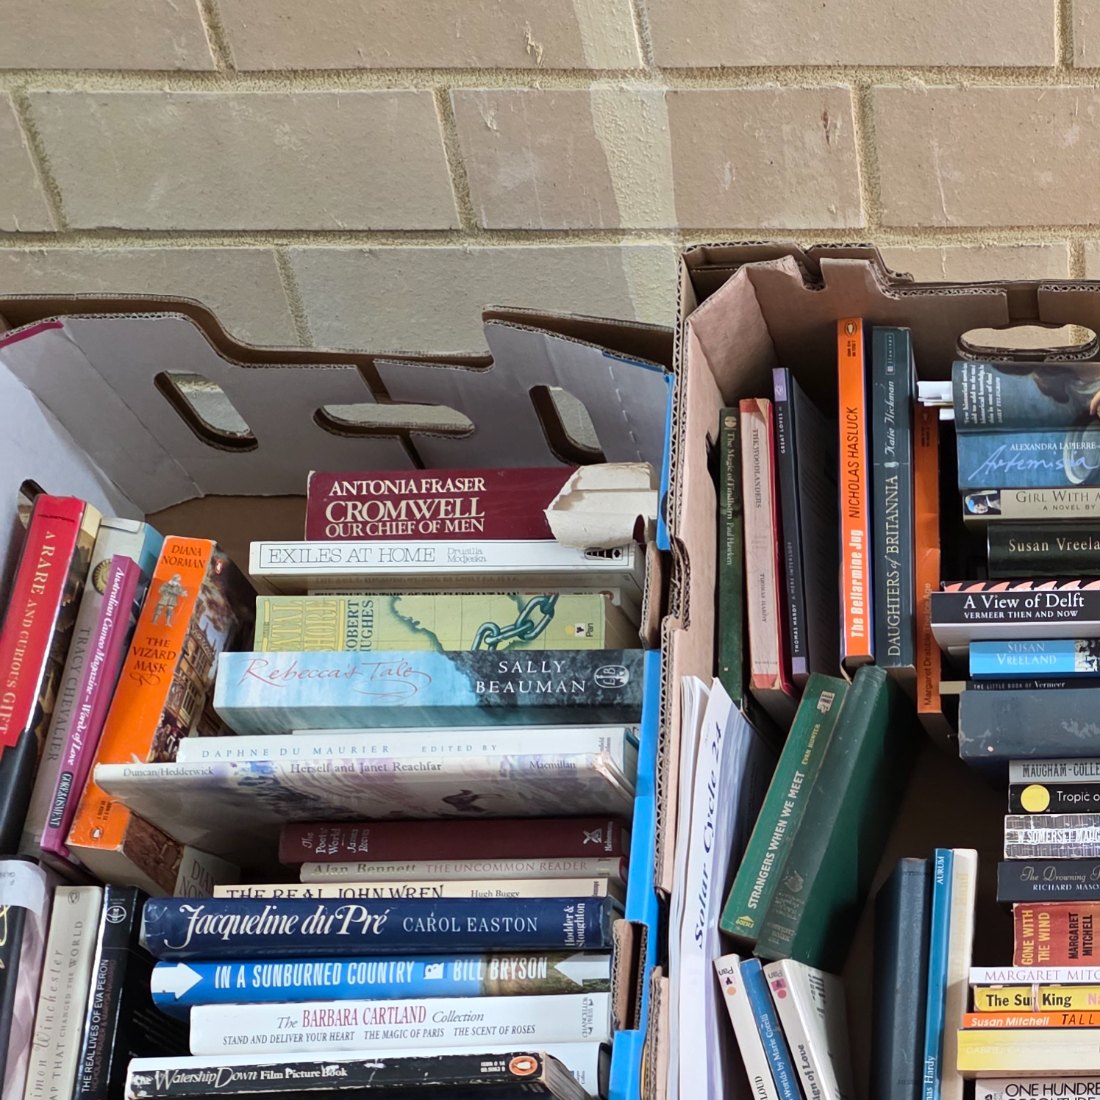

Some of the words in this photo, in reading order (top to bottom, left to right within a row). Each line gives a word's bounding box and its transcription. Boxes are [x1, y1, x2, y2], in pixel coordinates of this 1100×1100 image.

[847, 407, 859, 456] HASLUCK
[329, 479, 417, 496] ANTONIA
[421, 478, 486, 492] FRASER
[848, 459, 861, 519] NICHOLAS
[1016, 490, 1047, 503] GIRL
[1051, 490, 1087, 502] WITH
[325, 497, 485, 522] CROMWELL
[885, 475, 900, 554] BRITANNIA
[325, 523, 363, 538] OUR
[366, 521, 416, 536] CHIEF
[419, 520, 440, 534] OF
[445, 518, 485, 532] MEN
[849, 530, 864, 550] Jug
[1009, 538, 1049, 551] Susan
[269, 548, 342, 564] EXILES
[347, 549, 372, 563] AT
[379, 548, 435, 563] HOME
[884, 556, 902, 570] of
[851, 551, 864, 613] Bellarmine
[964, 595, 976, 609] A
[980, 594, 1020, 609] View
[1024, 592, 1042, 608] of
[1046, 591, 1084, 608] Delft
[887, 571, 901, 657] DAUGHTERS
[851, 614, 864, 638] The
[498, 660, 567, 674] SALLY
[476, 680, 585, 693] BEAUMAN
[202, 749, 269, 758] DAPHNE
[313, 745, 389, 754] MAURIER
[711, 722, 723, 763] 24
[784, 771, 806, 801] MEET
[1057, 789, 1089, 803] Tropic
[702, 767, 720, 854] Cycle
[782, 794, 795, 814] WE
[766, 808, 790, 852] WHEN
[747, 839, 783, 910] STRANGERS
[694, 861, 716, 951] Solar
[164, 904, 299, 949] Jacqueline
[301, 905, 335, 935] du
[335, 904, 388, 935] Pré
[403, 917, 461, 932] CAROL
[467, 917, 538, 932] EASTON
[215, 966, 230, 988] IN
[236, 965, 246, 987] A
[252, 962, 340, 988] SUNBURNED
[347, 961, 413, 985] COUNTRY
[453, 959, 483, 981] BILL
[490, 957, 547, 979] BRYSON
[984, 970, 1061, 981] MARGARET
[277, 1016, 298, 1029] The
[302, 1009, 358, 1028] BARBARA
[363, 1005, 427, 1024] CARTLAND
[432, 1010, 484, 1024] Collection
[1061, 1013, 1096, 1025] TALL
[1005, 1082, 1040, 1097] ONE
